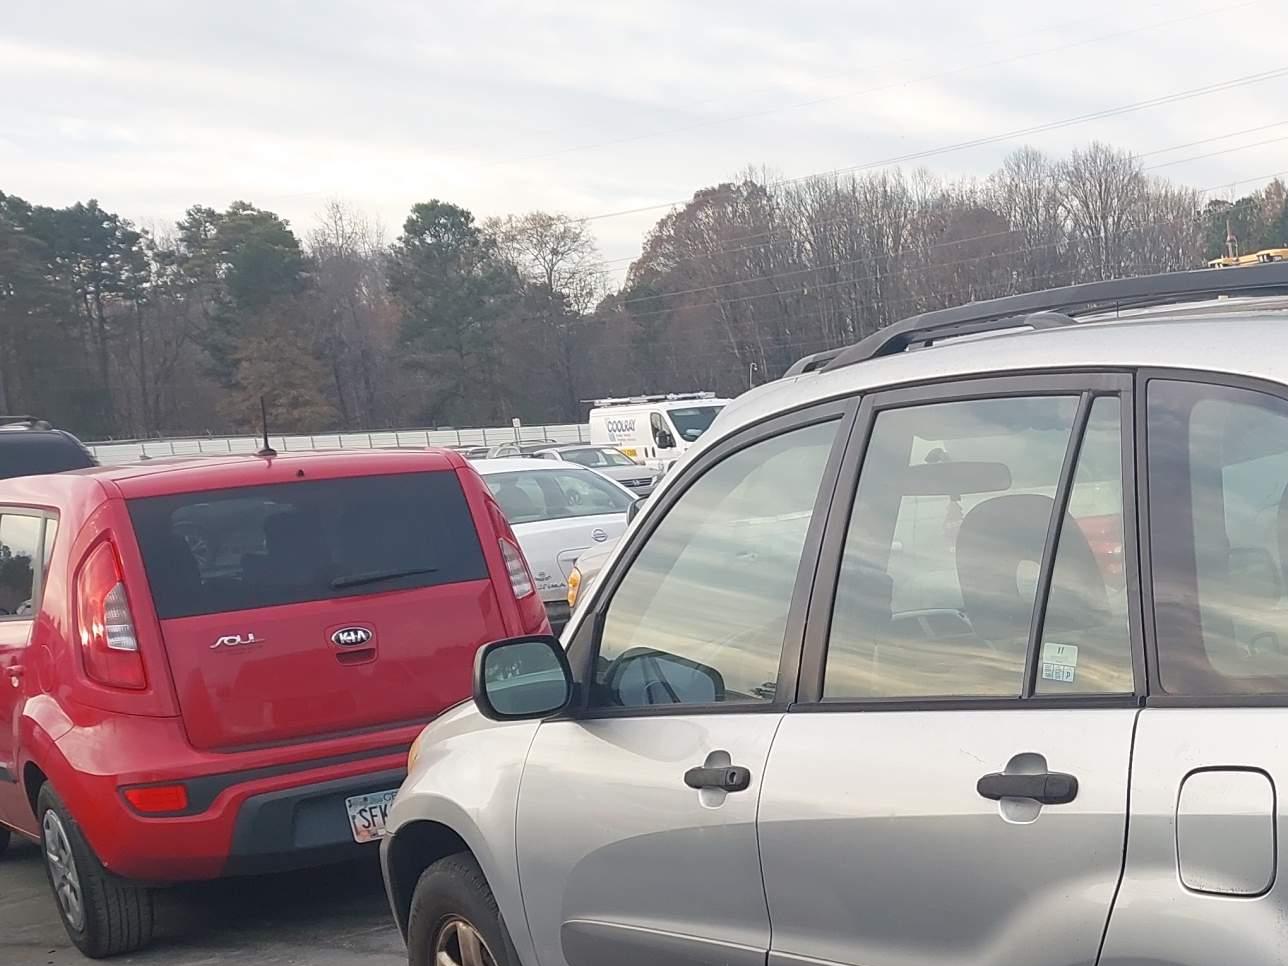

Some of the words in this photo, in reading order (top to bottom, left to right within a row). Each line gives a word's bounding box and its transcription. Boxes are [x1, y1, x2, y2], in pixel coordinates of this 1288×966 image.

[607, 419, 636, 433] COOLRAY
[209, 633, 264, 649] SOUL
[338, 630, 367, 644] KIA
